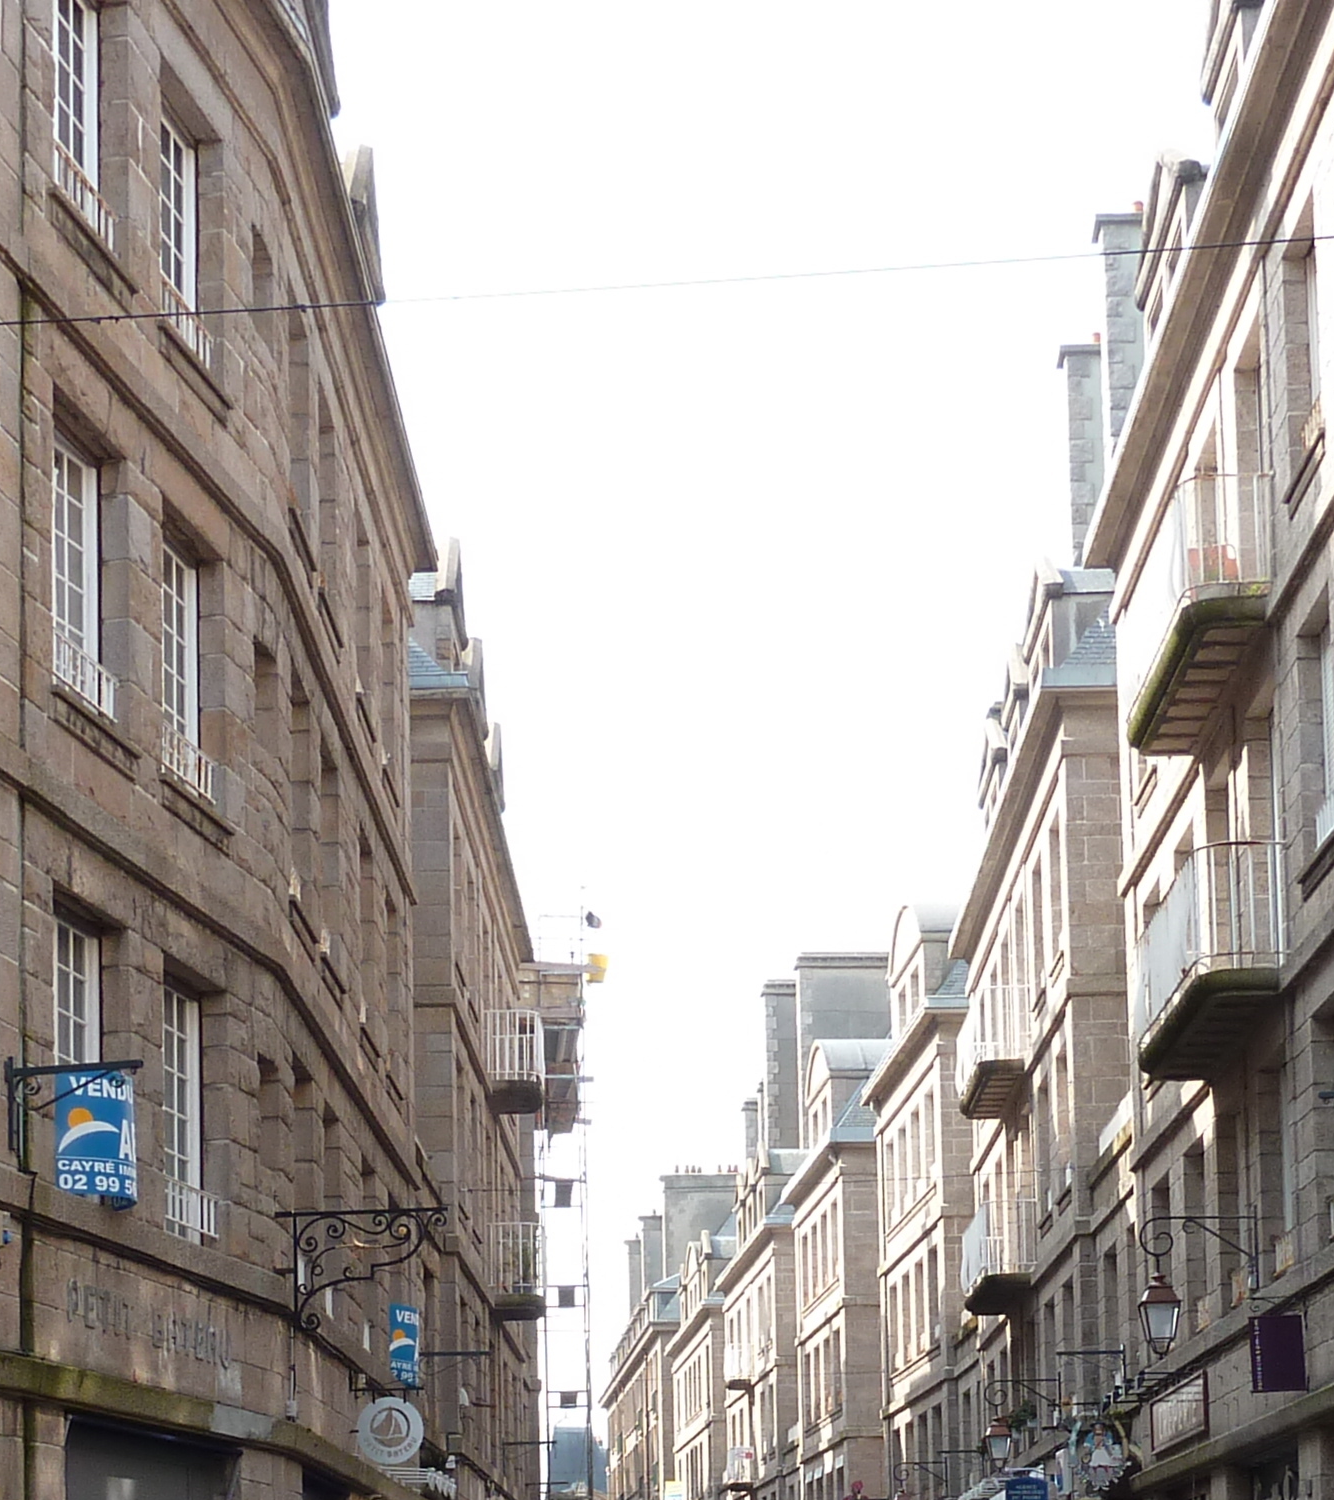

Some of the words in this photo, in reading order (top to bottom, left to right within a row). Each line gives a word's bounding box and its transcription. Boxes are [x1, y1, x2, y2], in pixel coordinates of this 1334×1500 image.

[57, 1160, 115, 1174] CAYRÉ
[59, 1174, 88, 1190] 02
[95, 1175, 120, 1192] 99
[67, 1278, 133, 1340] PETIT
